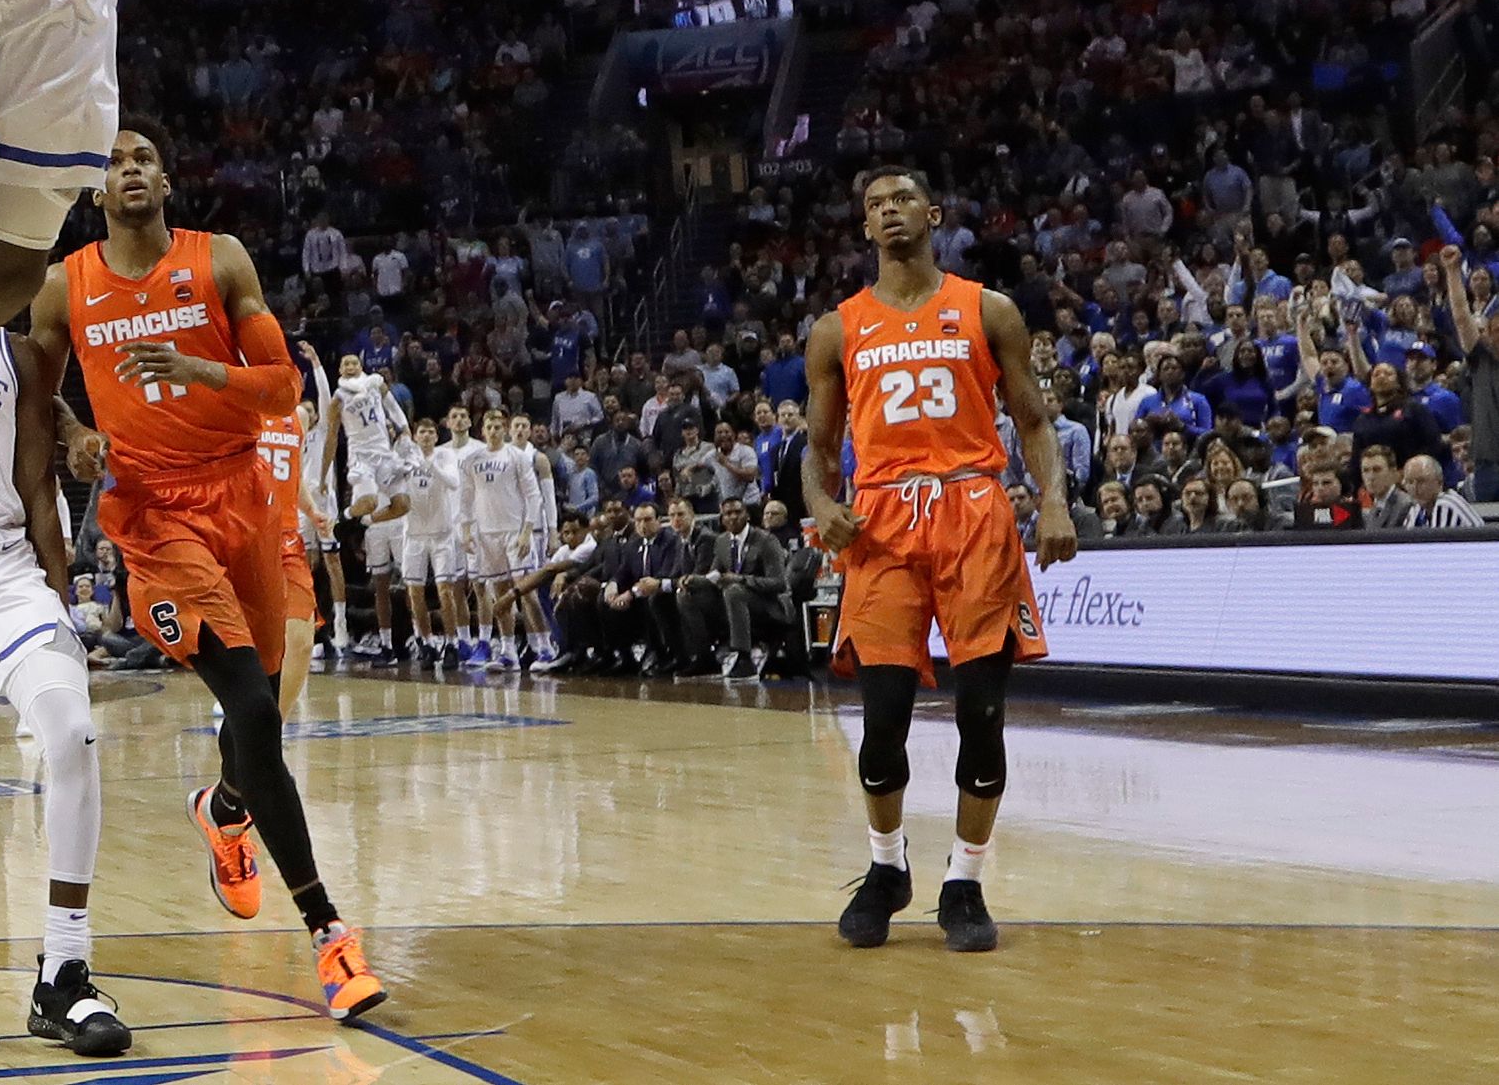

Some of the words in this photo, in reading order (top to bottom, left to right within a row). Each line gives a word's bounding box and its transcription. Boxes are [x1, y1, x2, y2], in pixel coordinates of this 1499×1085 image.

[85, 303, 209, 347] SYRACUSE
[856, 339, 970, 371] SYRACUSE
[880, 366, 958, 426] 23
[359, 407, 378, 428] 14
[261, 432, 300, 447] ACUSE
[474, 459, 508, 474] FAMILY
[149, 600, 183, 645] S
[1018, 601, 1039, 640] S
